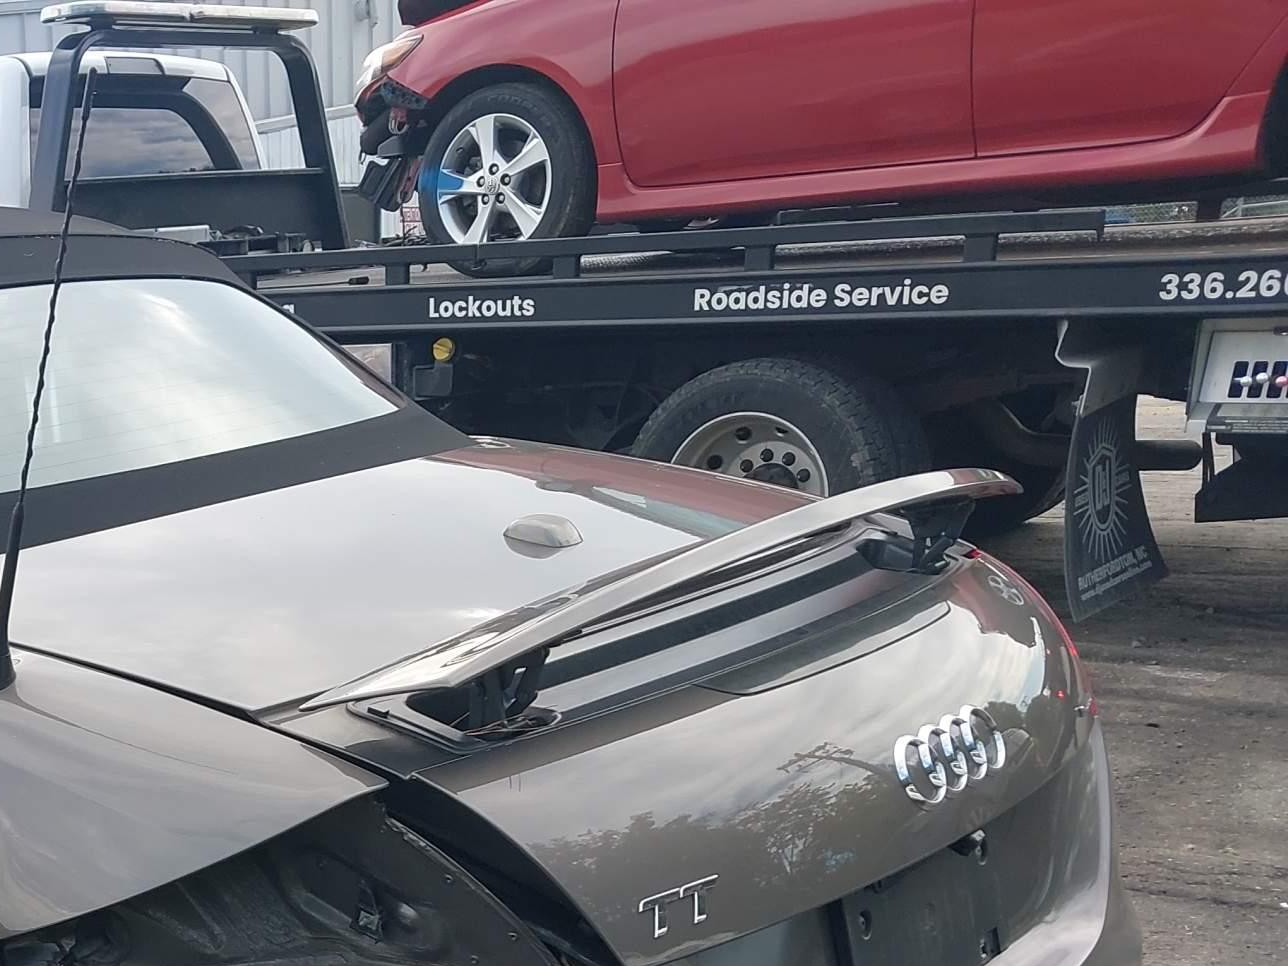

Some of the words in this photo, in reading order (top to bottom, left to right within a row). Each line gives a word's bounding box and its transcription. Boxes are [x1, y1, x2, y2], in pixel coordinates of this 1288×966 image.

[694, 283, 827, 311] Roadside
[834, 278, 949, 307] Service
[1159, 269, 1288, 300] 336.26
[429, 295, 535, 318] Lockouts
[638, 874, 719, 938] TT
